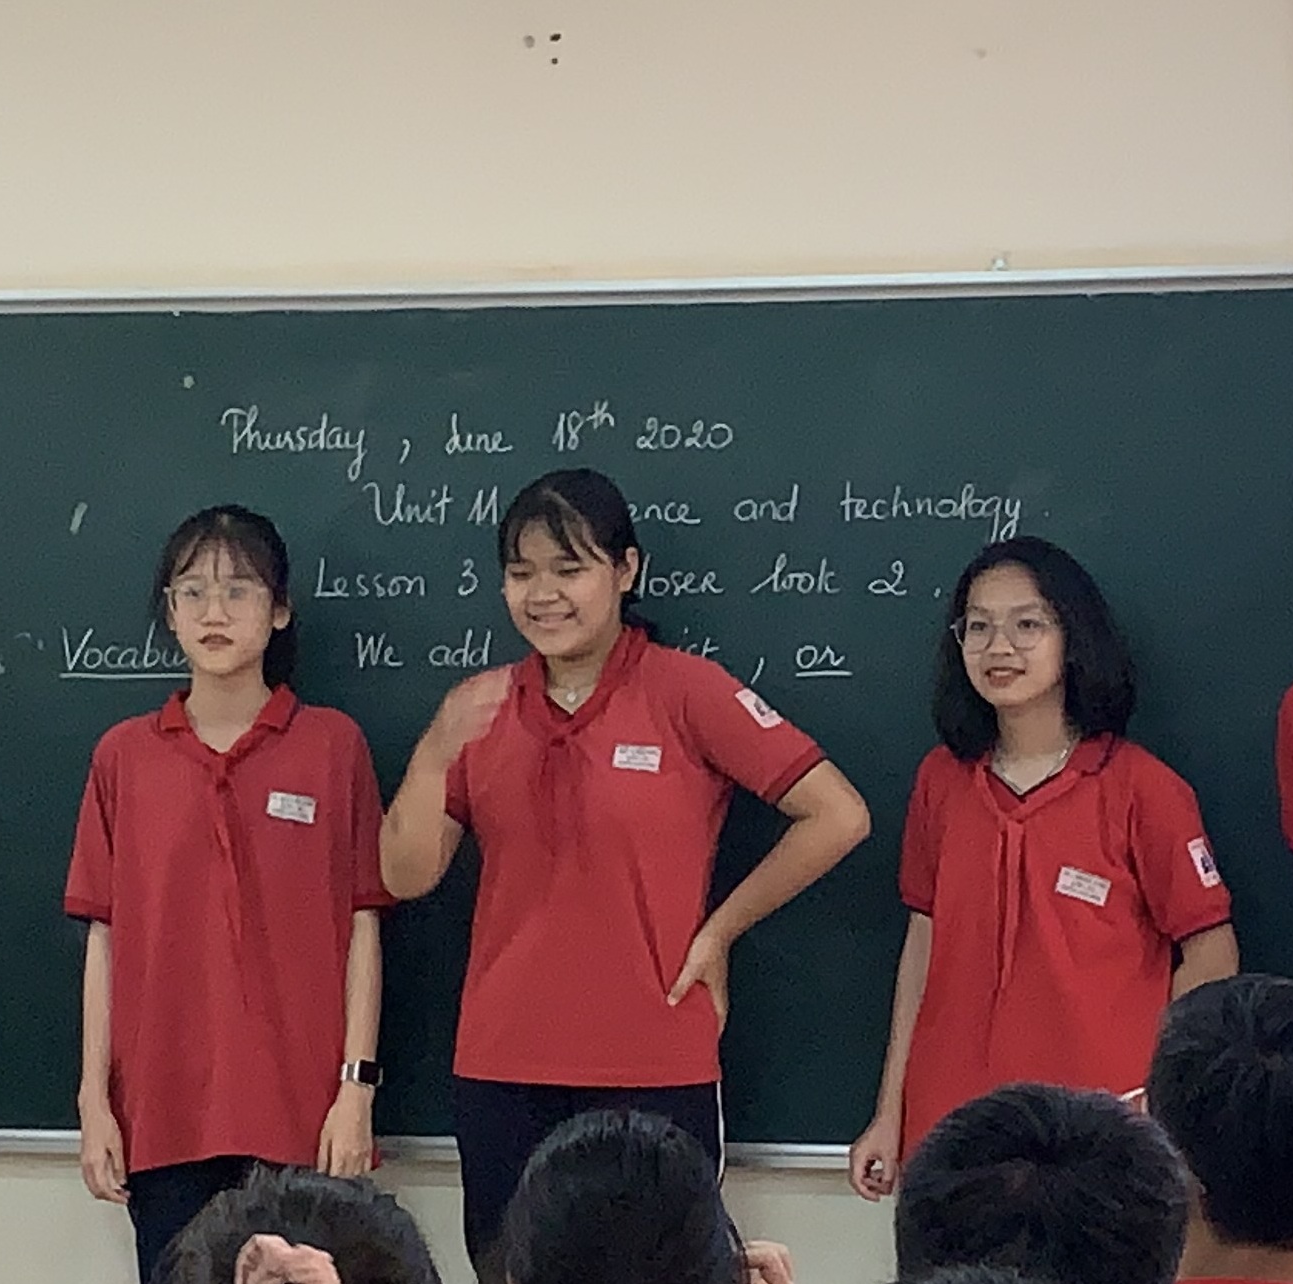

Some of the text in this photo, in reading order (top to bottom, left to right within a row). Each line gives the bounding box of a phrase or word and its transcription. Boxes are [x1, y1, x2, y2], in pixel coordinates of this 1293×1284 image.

[636, 417, 733, 450] 2020
[362, 482, 453, 525] Unit
[734, 484, 798, 521] and
[314, 558, 424, 597] Lesson
[458, 559, 478, 596] 3
[634, 552, 723, 598] loser
[750, 553, 840, 593] look
[355, 633, 403, 668] We
[429, 629, 491, 667] add
